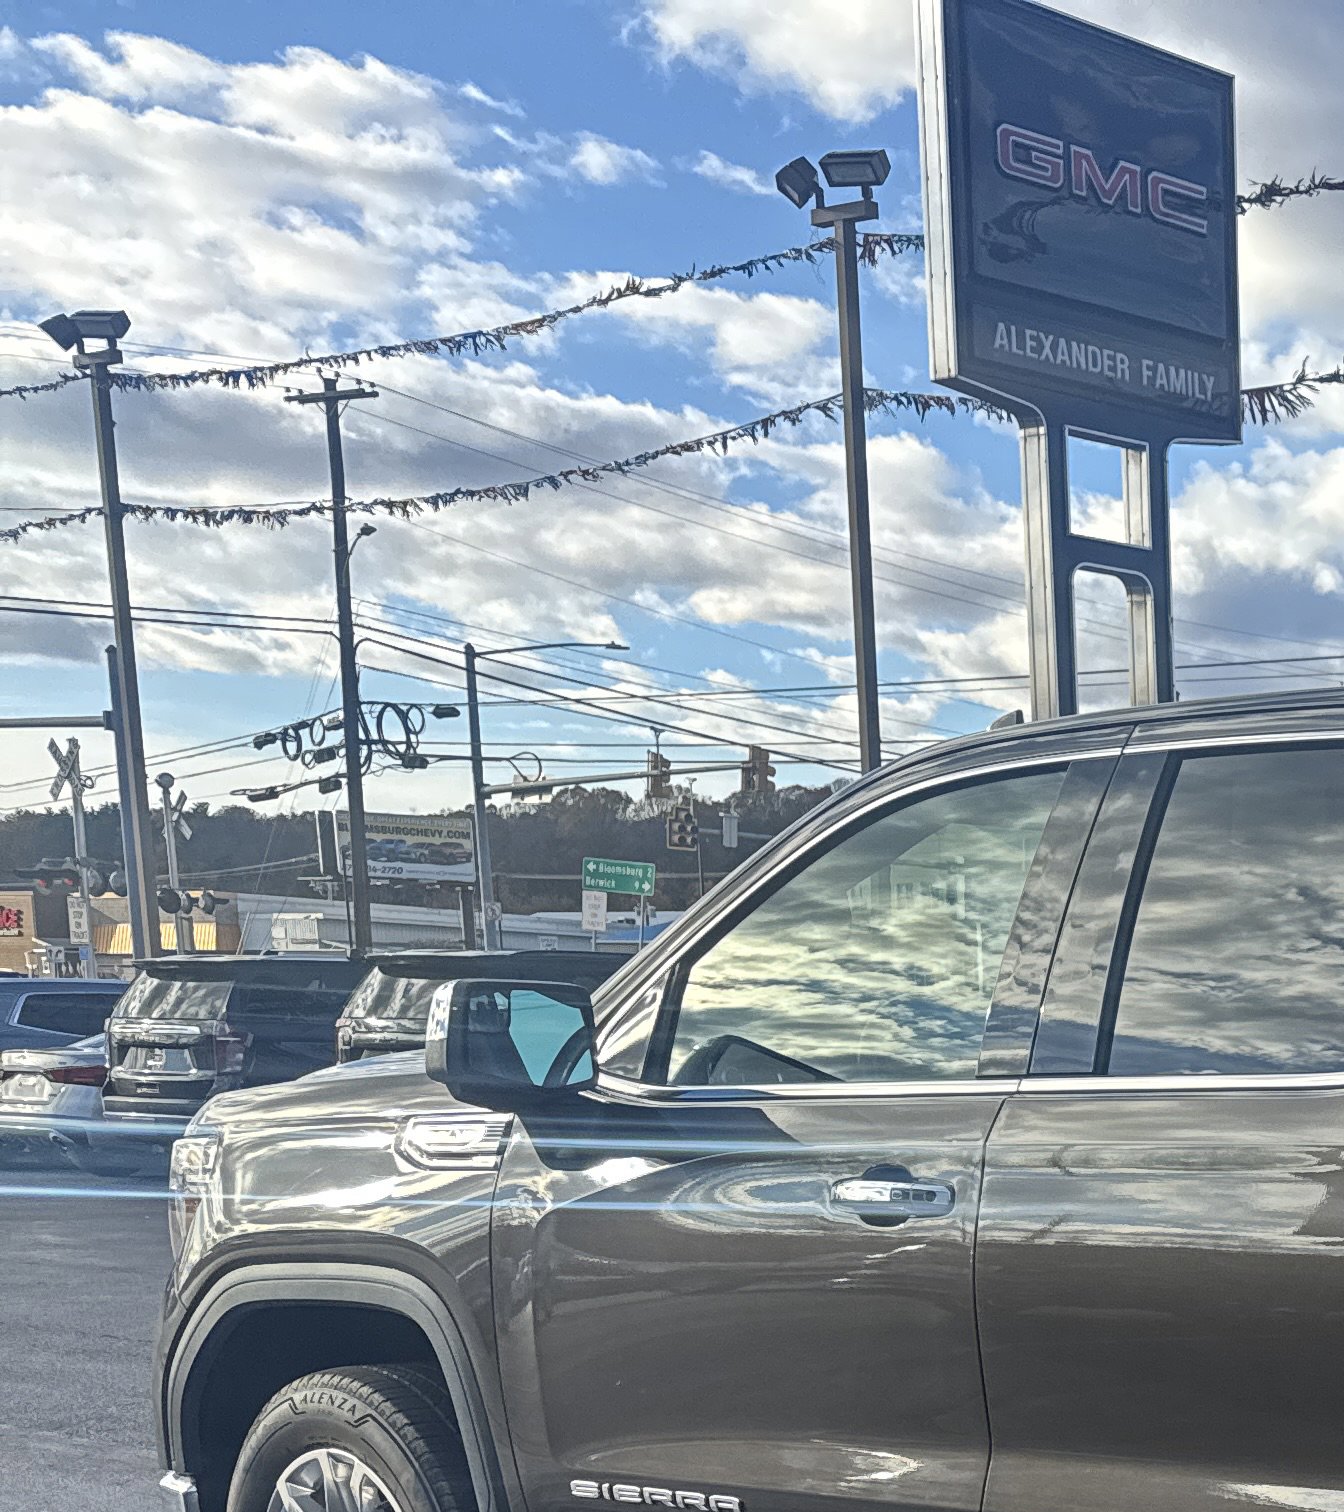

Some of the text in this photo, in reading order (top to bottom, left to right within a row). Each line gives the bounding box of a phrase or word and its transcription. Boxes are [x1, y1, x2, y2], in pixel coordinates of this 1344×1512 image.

[997, 123, 1207, 234] GMC
[993, 322, 1216, 403] ALEXANDER FAMILY
[338, 823, 471, 841] BLMSBURGCHEVY.COM
[599, 863, 653, 879] Bloomsburg 2
[585, 876, 640, 890] Berwick 9
[299, 1391, 358, 1417] ALENZA
